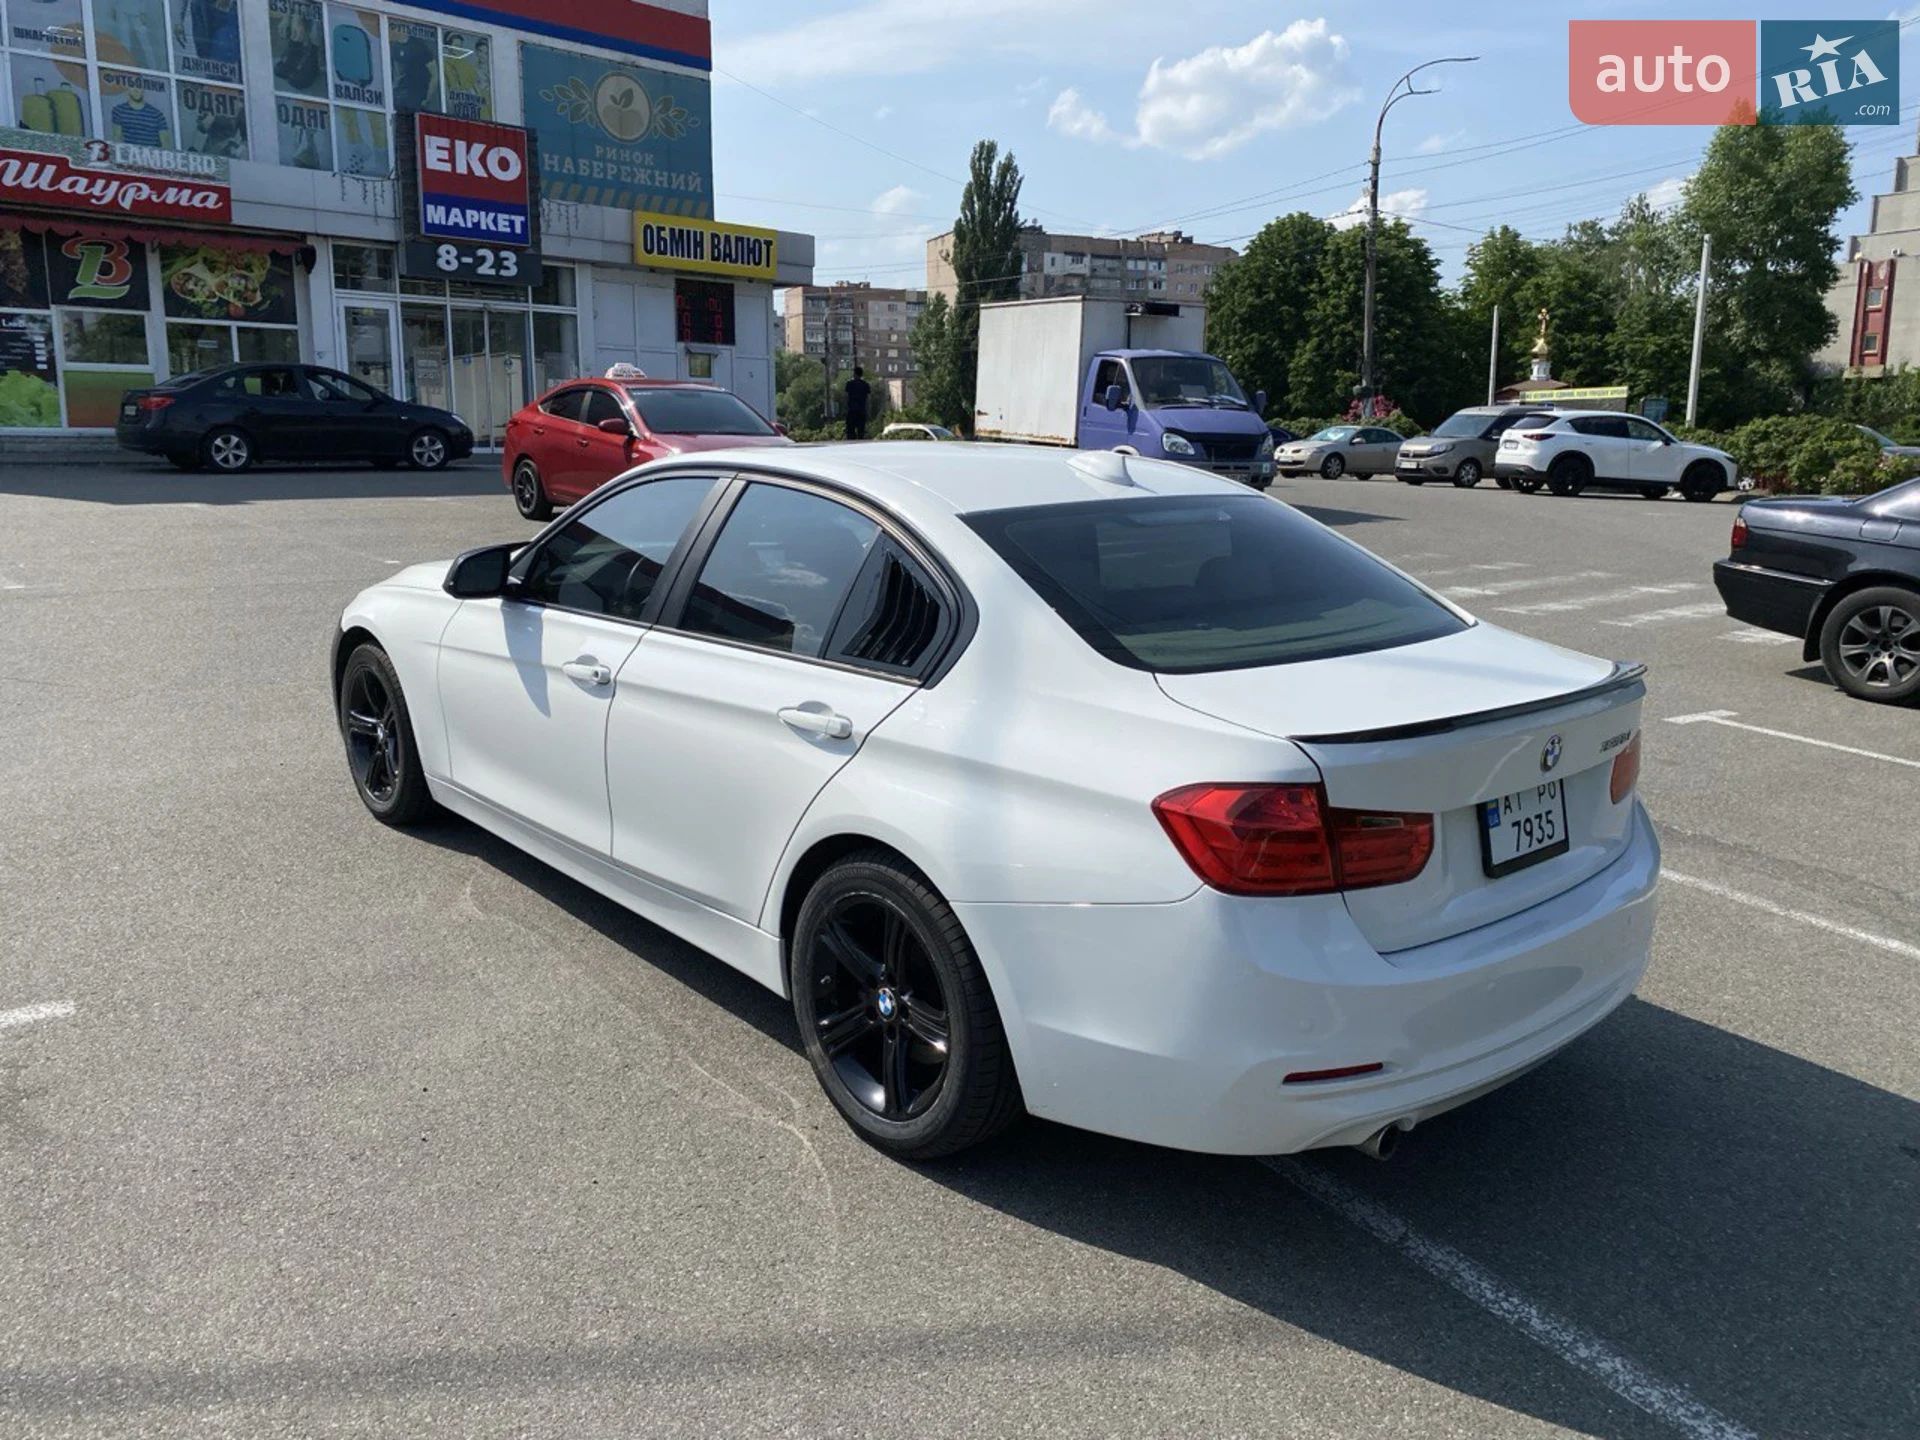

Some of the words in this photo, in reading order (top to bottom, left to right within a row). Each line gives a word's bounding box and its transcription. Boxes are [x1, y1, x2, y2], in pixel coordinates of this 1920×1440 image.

[182, 56, 236, 78] ДЖИНСИ
[183, 88, 237, 116] ОДЯГ
[334, 84, 383, 106] ВАЛІЗИ
[277, 103, 328, 130] ОДЯГ
[424, 134, 522, 182] ЕКО
[595, 144, 655, 166] РИНОК
[0, 158, 223, 210] Шаурма
[543, 153, 703, 193] НАБЕРЕЖНИЙ
[426, 204, 525, 234] МАРКЕТ
[436, 243, 518, 277] 8-23
[643, 223, 704, 261] ОБМІН
[710, 232, 773, 268] ВАЛЮТ
[1512, 810, 1555, 852] 7935
